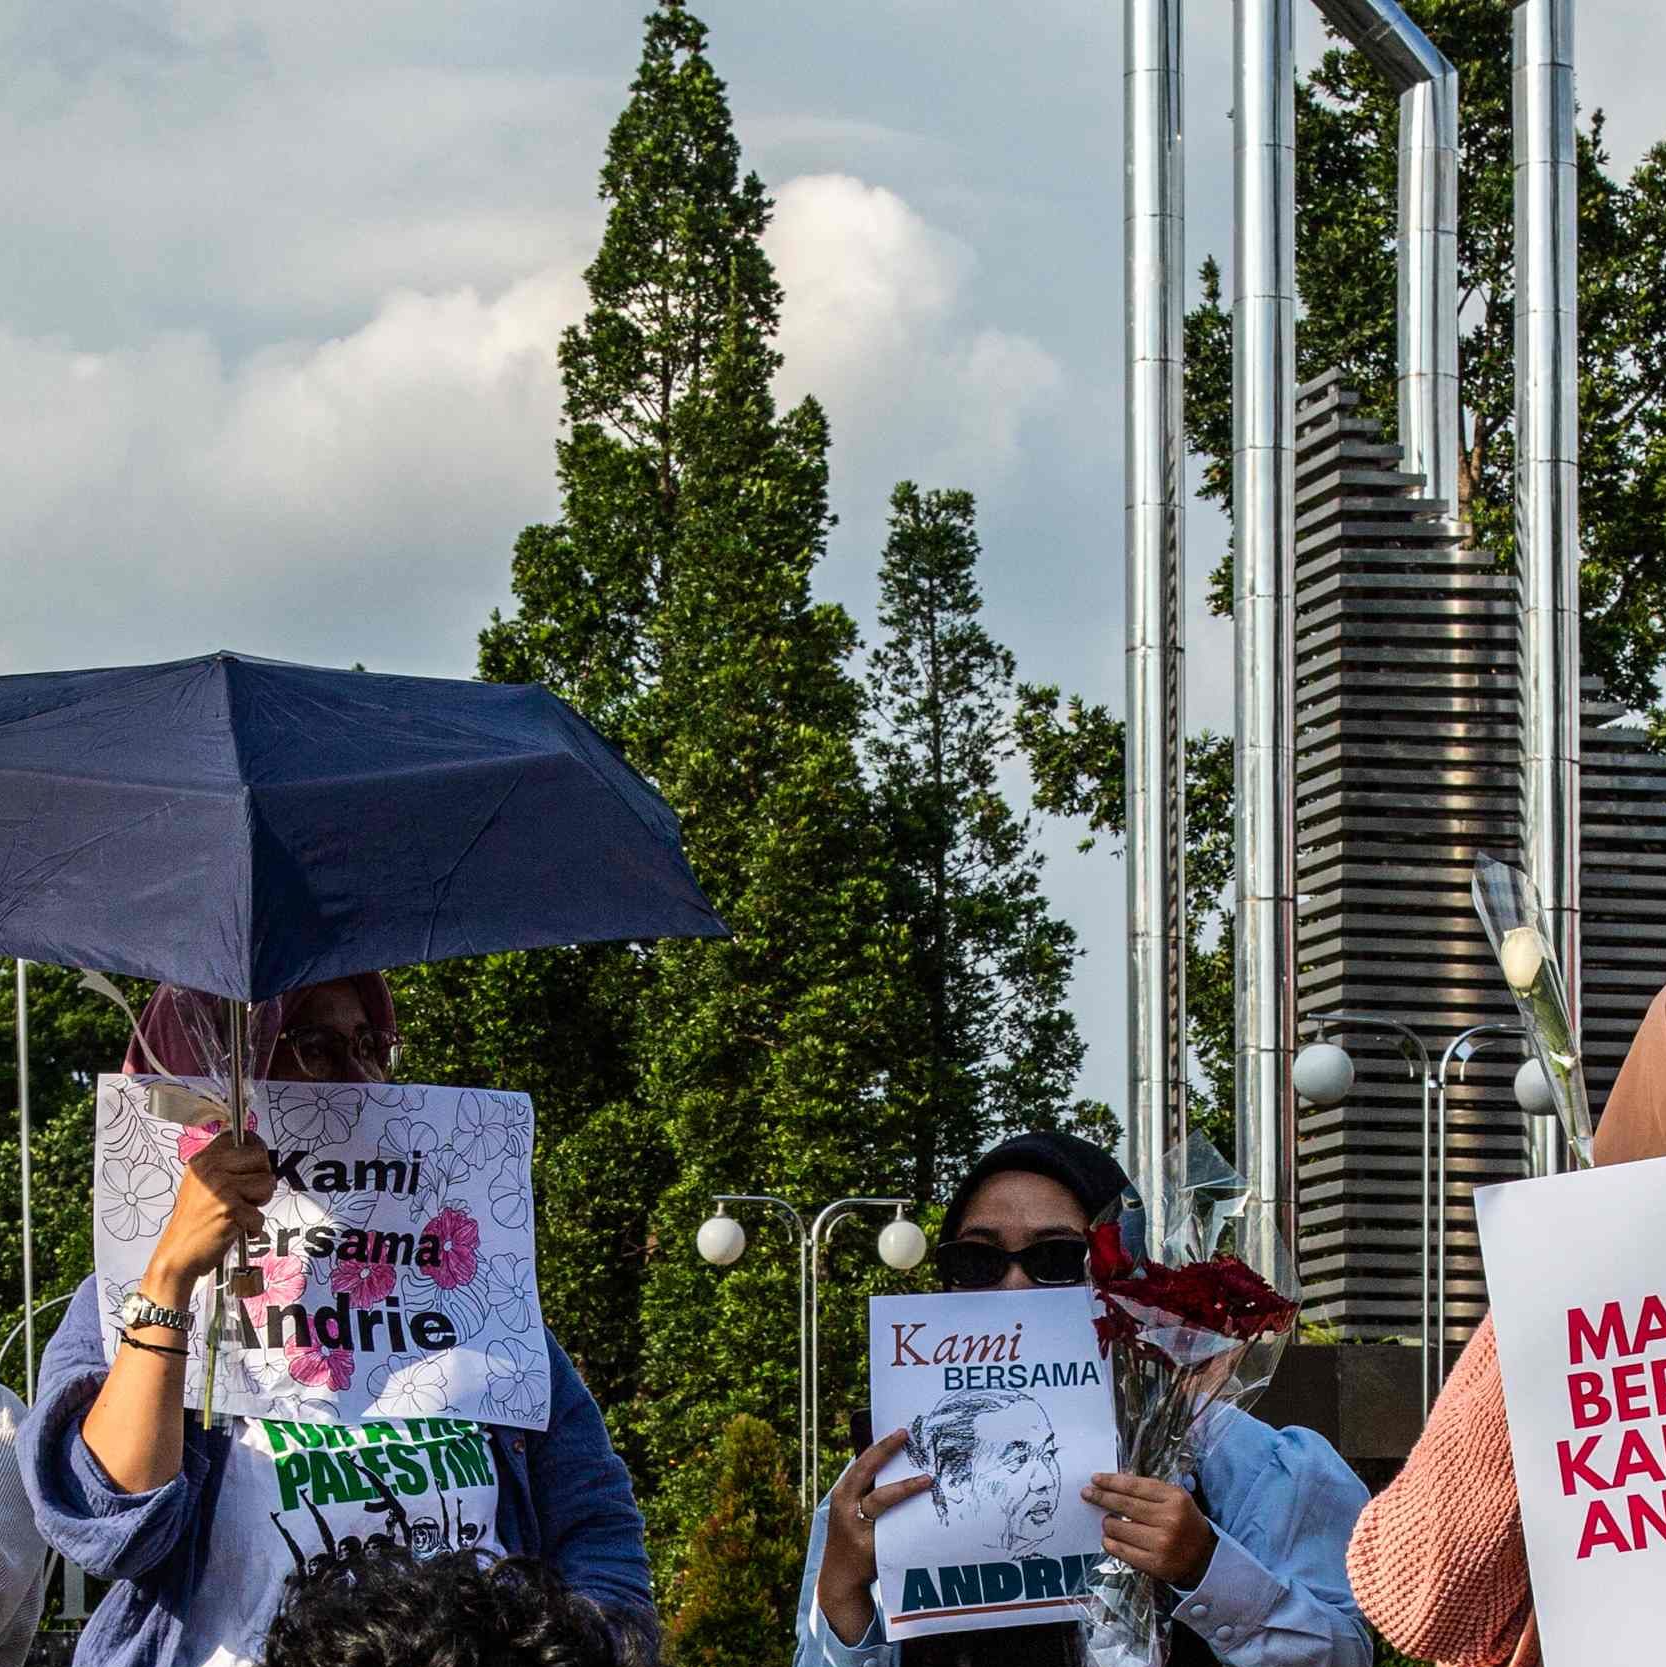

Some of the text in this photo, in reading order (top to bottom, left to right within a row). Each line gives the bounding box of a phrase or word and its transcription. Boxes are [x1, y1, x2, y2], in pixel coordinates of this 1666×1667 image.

[268, 1149, 421, 1194] Kami
[246, 1226, 441, 1267] ersama
[891, 1323, 1023, 1367] Kami
[944, 1362, 1100, 1391] BERSAMA
